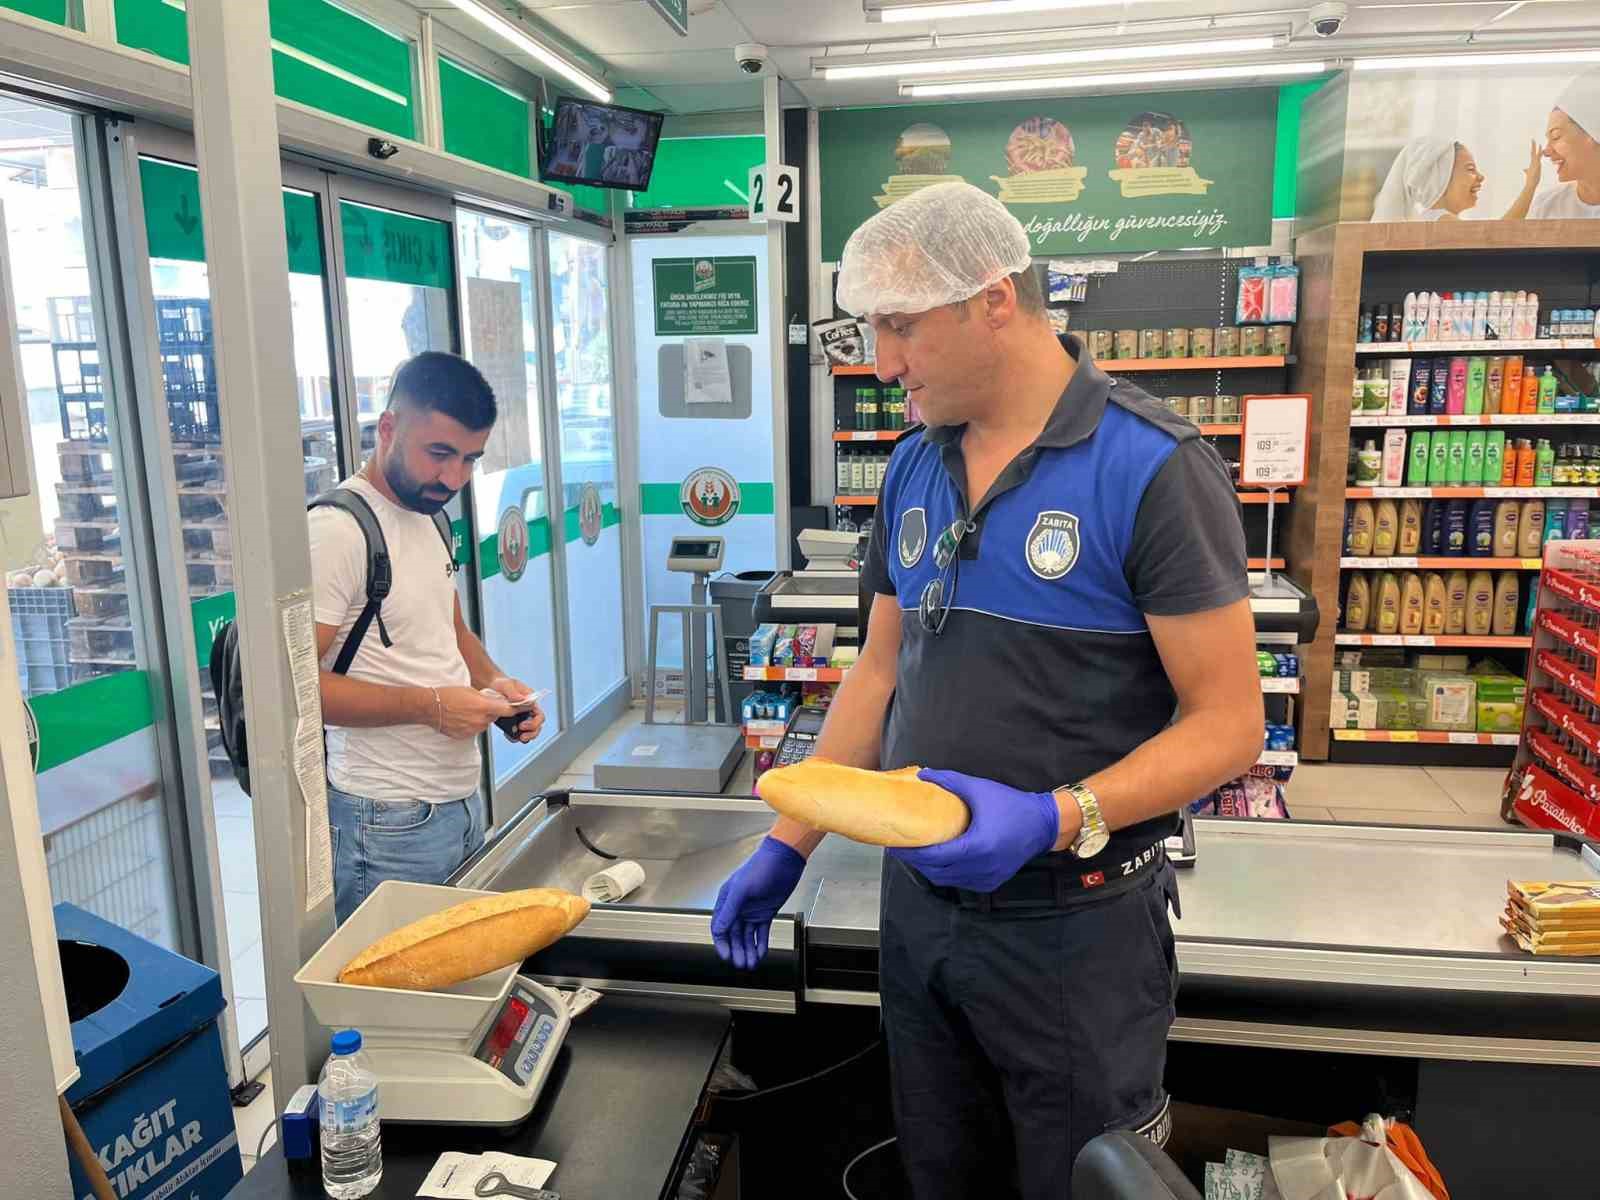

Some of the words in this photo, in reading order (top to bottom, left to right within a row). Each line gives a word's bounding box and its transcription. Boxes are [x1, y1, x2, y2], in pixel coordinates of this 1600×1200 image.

[754, 174, 763, 213] 2
[777, 173, 793, 213] 2
[1024, 213, 1109, 244] doğallığın
[1109, 207, 1229, 241] güvencesiyiz.
[1041, 517, 1074, 530] ZABITA
[96, 1099, 177, 1172] KAĞIT
